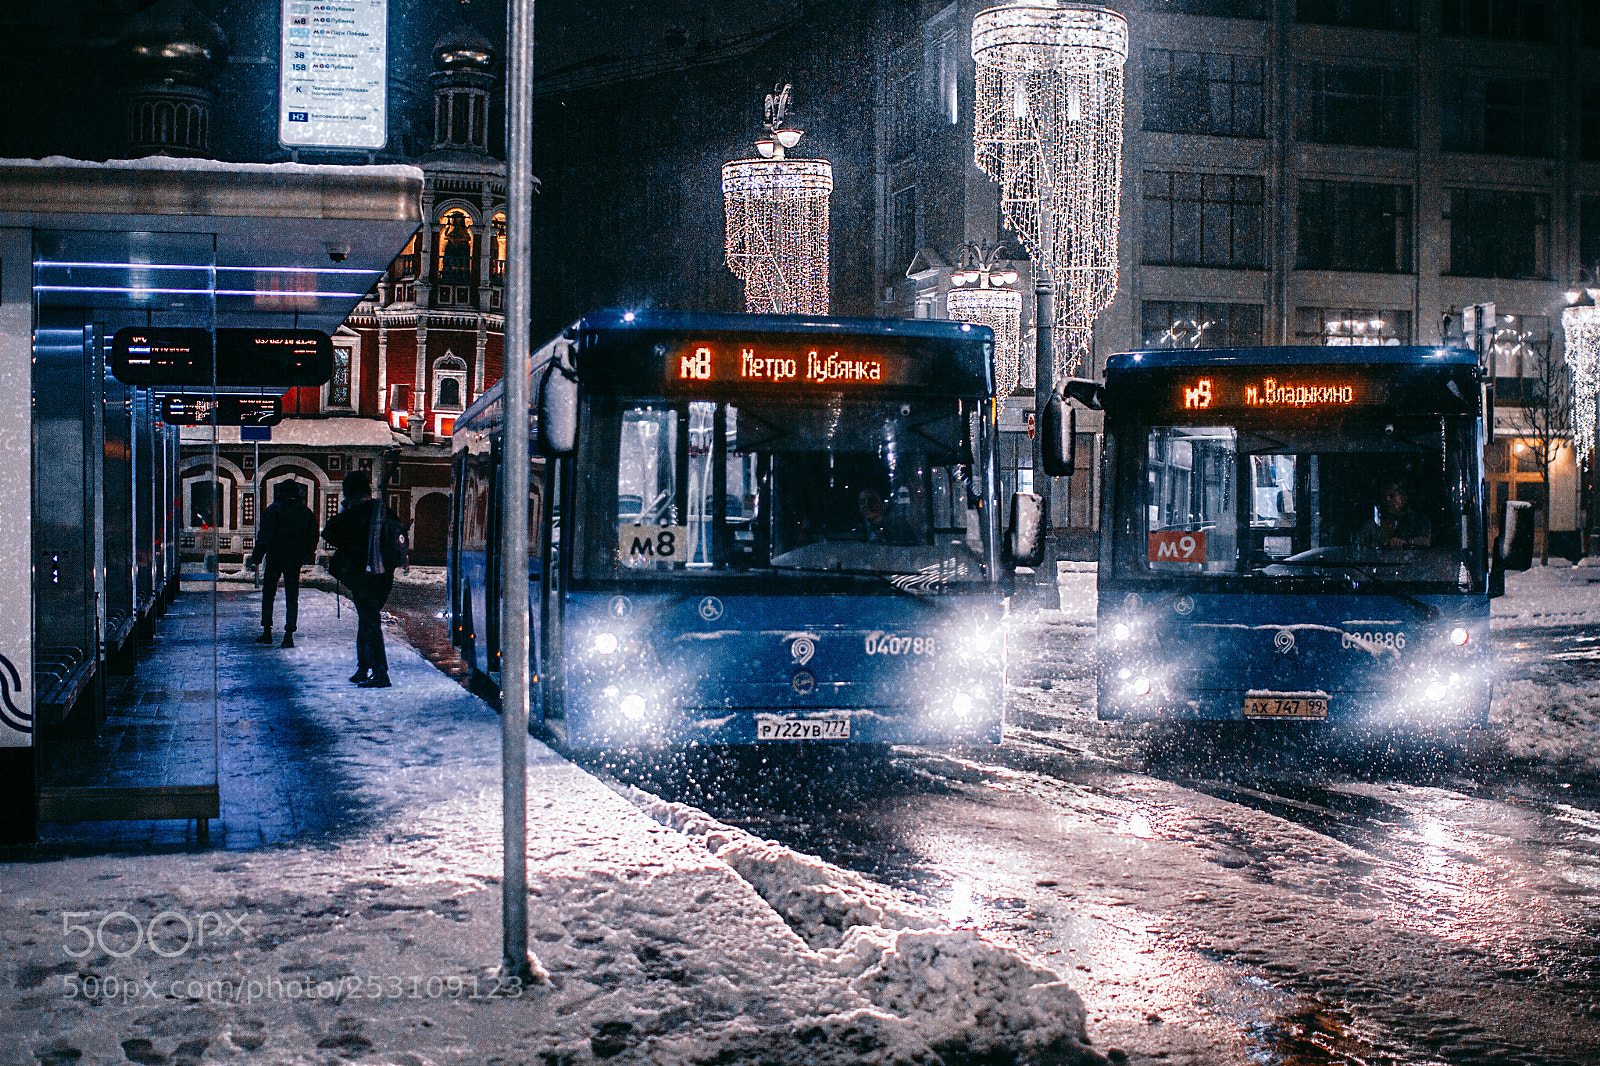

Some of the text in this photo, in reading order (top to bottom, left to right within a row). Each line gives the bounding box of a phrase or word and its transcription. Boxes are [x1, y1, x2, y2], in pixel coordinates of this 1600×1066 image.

[294, 51, 305, 59] 38
[292, 63, 306, 71] 158
[741, 348, 796, 382] Метро
[806, 350, 881, 382] Лубянка
[864, 636, 936, 655] 040788
